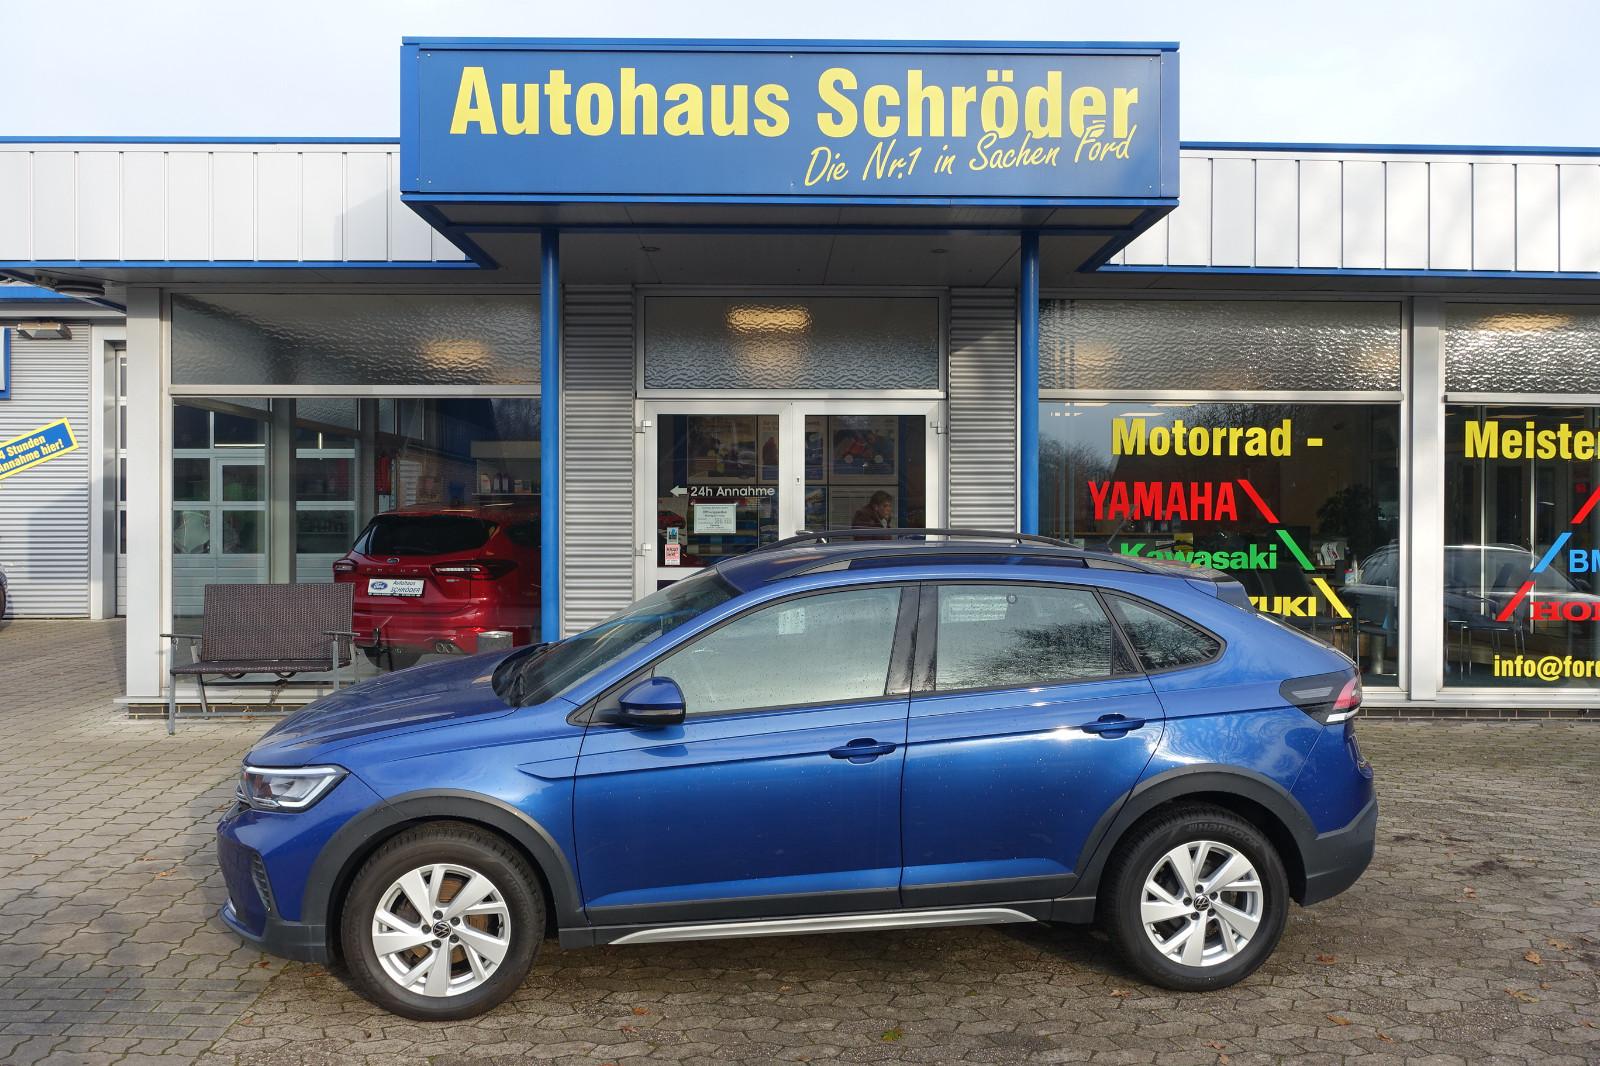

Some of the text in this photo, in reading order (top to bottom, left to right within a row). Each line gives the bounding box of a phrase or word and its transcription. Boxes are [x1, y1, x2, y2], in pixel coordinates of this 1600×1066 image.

[451, 67, 1138, 140] Autohaus Schröder
[804, 120, 1138, 187] Die Nr.1 in Sachen Ford
[6, 435, 46, 457] Stunden
[40, 438, 65, 456] hier!
[1112, 417, 1291, 457] Motorrad
[1464, 421, 1600, 460] Meiste
[690, 486, 775, 497] 24h Annahme
[1087, 480, 1238, 521] YAMAHA
